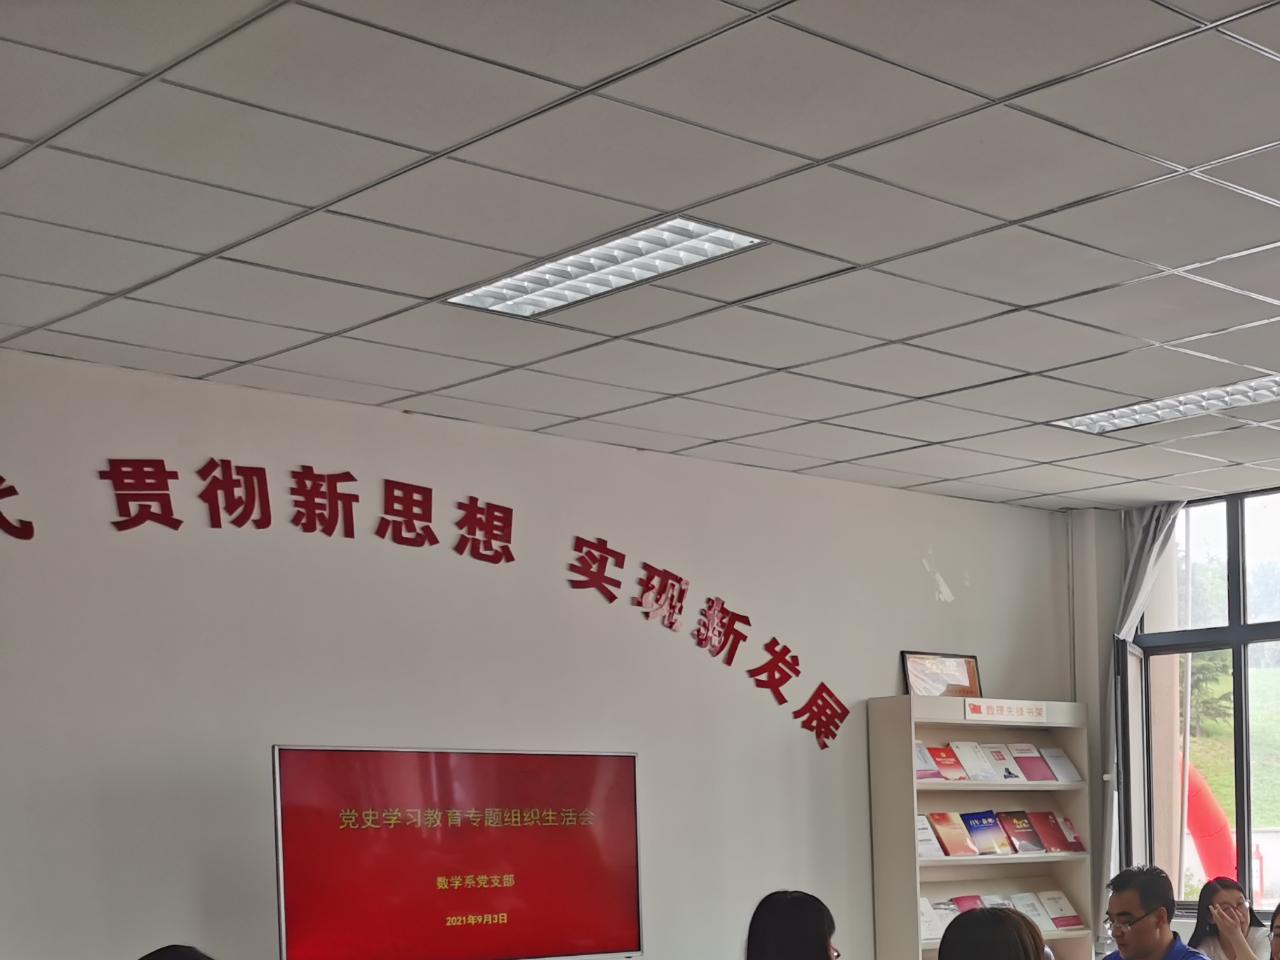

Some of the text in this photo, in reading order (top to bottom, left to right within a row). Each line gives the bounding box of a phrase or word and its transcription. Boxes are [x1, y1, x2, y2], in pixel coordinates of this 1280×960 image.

[97, 457, 852, 749] 贯彻新思想 实现新发展
[338, 807, 596, 829] 党史学习教育专题组织生活会
[436, 874, 516, 890] 数学系党支部
[446, 913, 508, 926] 2021年9月3日
